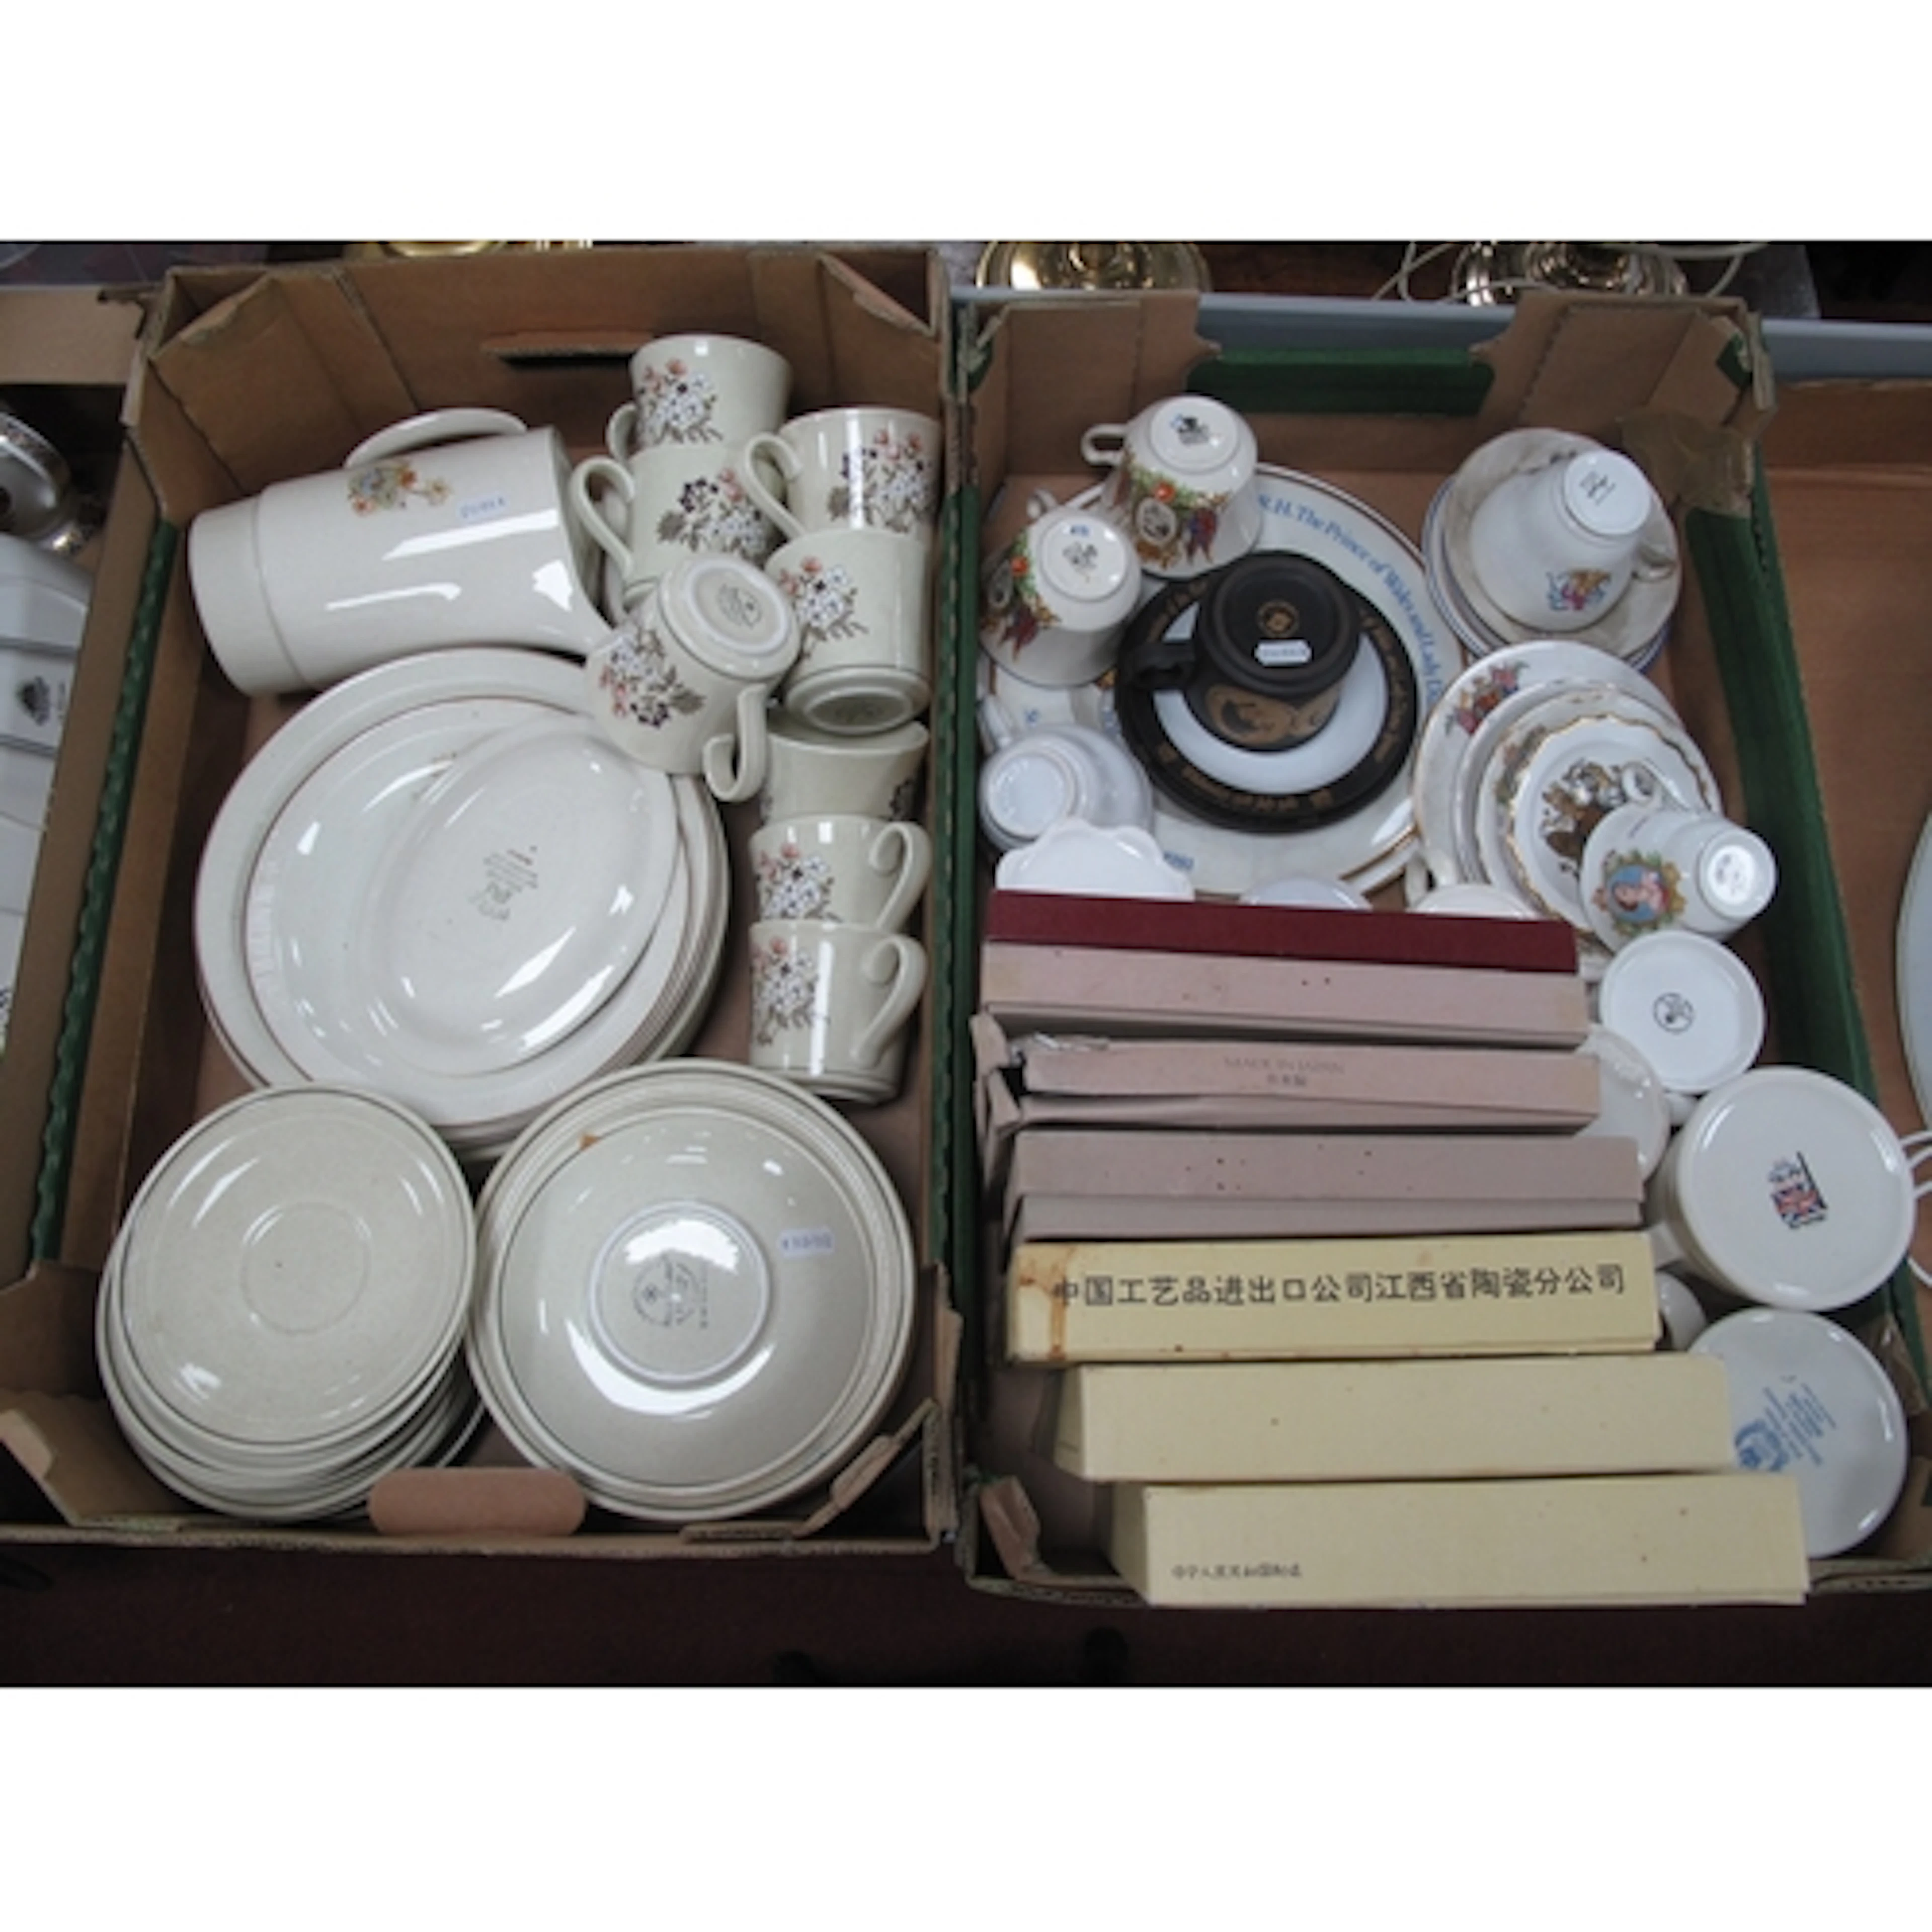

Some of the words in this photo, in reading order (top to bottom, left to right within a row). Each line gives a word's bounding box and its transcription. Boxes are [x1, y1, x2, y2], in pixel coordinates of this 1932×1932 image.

[1297, 506, 1326, 528] The
[1324, 520, 1369, 560] Prince
[1053, 1263, 1624, 1307] 中国工艺品进出口公司江西省陶瓷分公司
